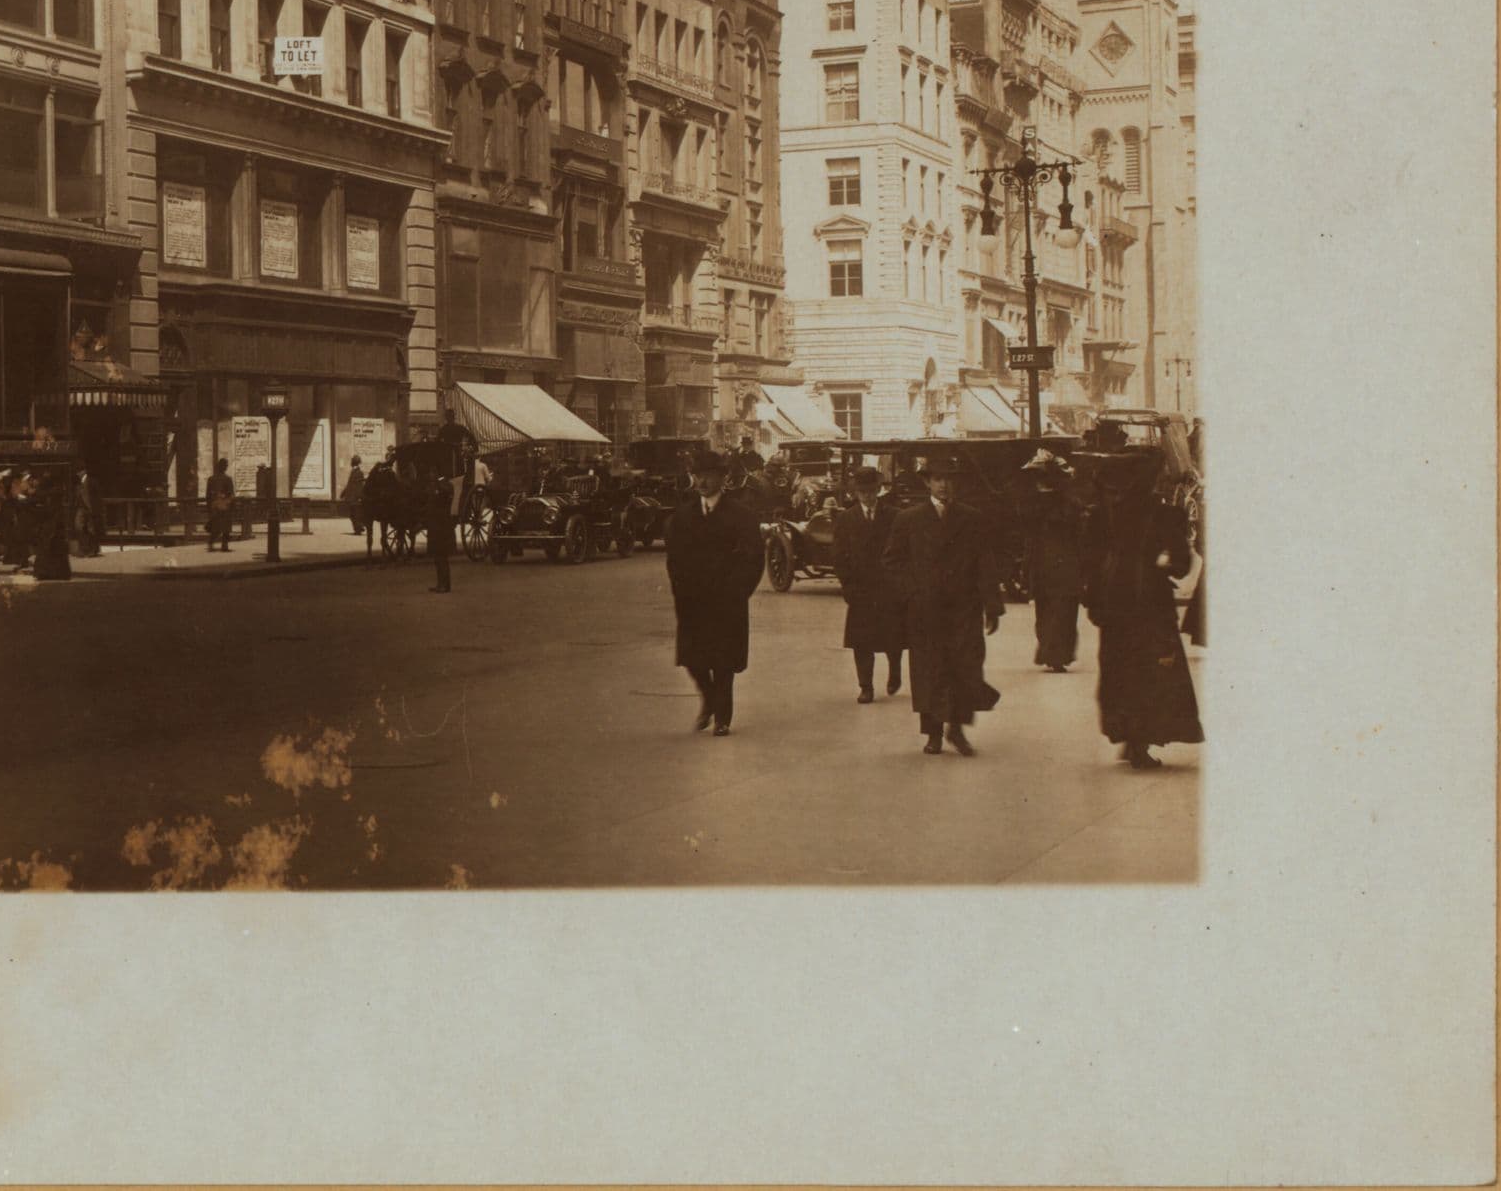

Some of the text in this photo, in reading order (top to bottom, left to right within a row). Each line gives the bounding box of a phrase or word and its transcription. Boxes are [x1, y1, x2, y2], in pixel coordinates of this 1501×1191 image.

[286, 40, 312, 49] LOFT
[280, 50, 317, 62] TO LET
